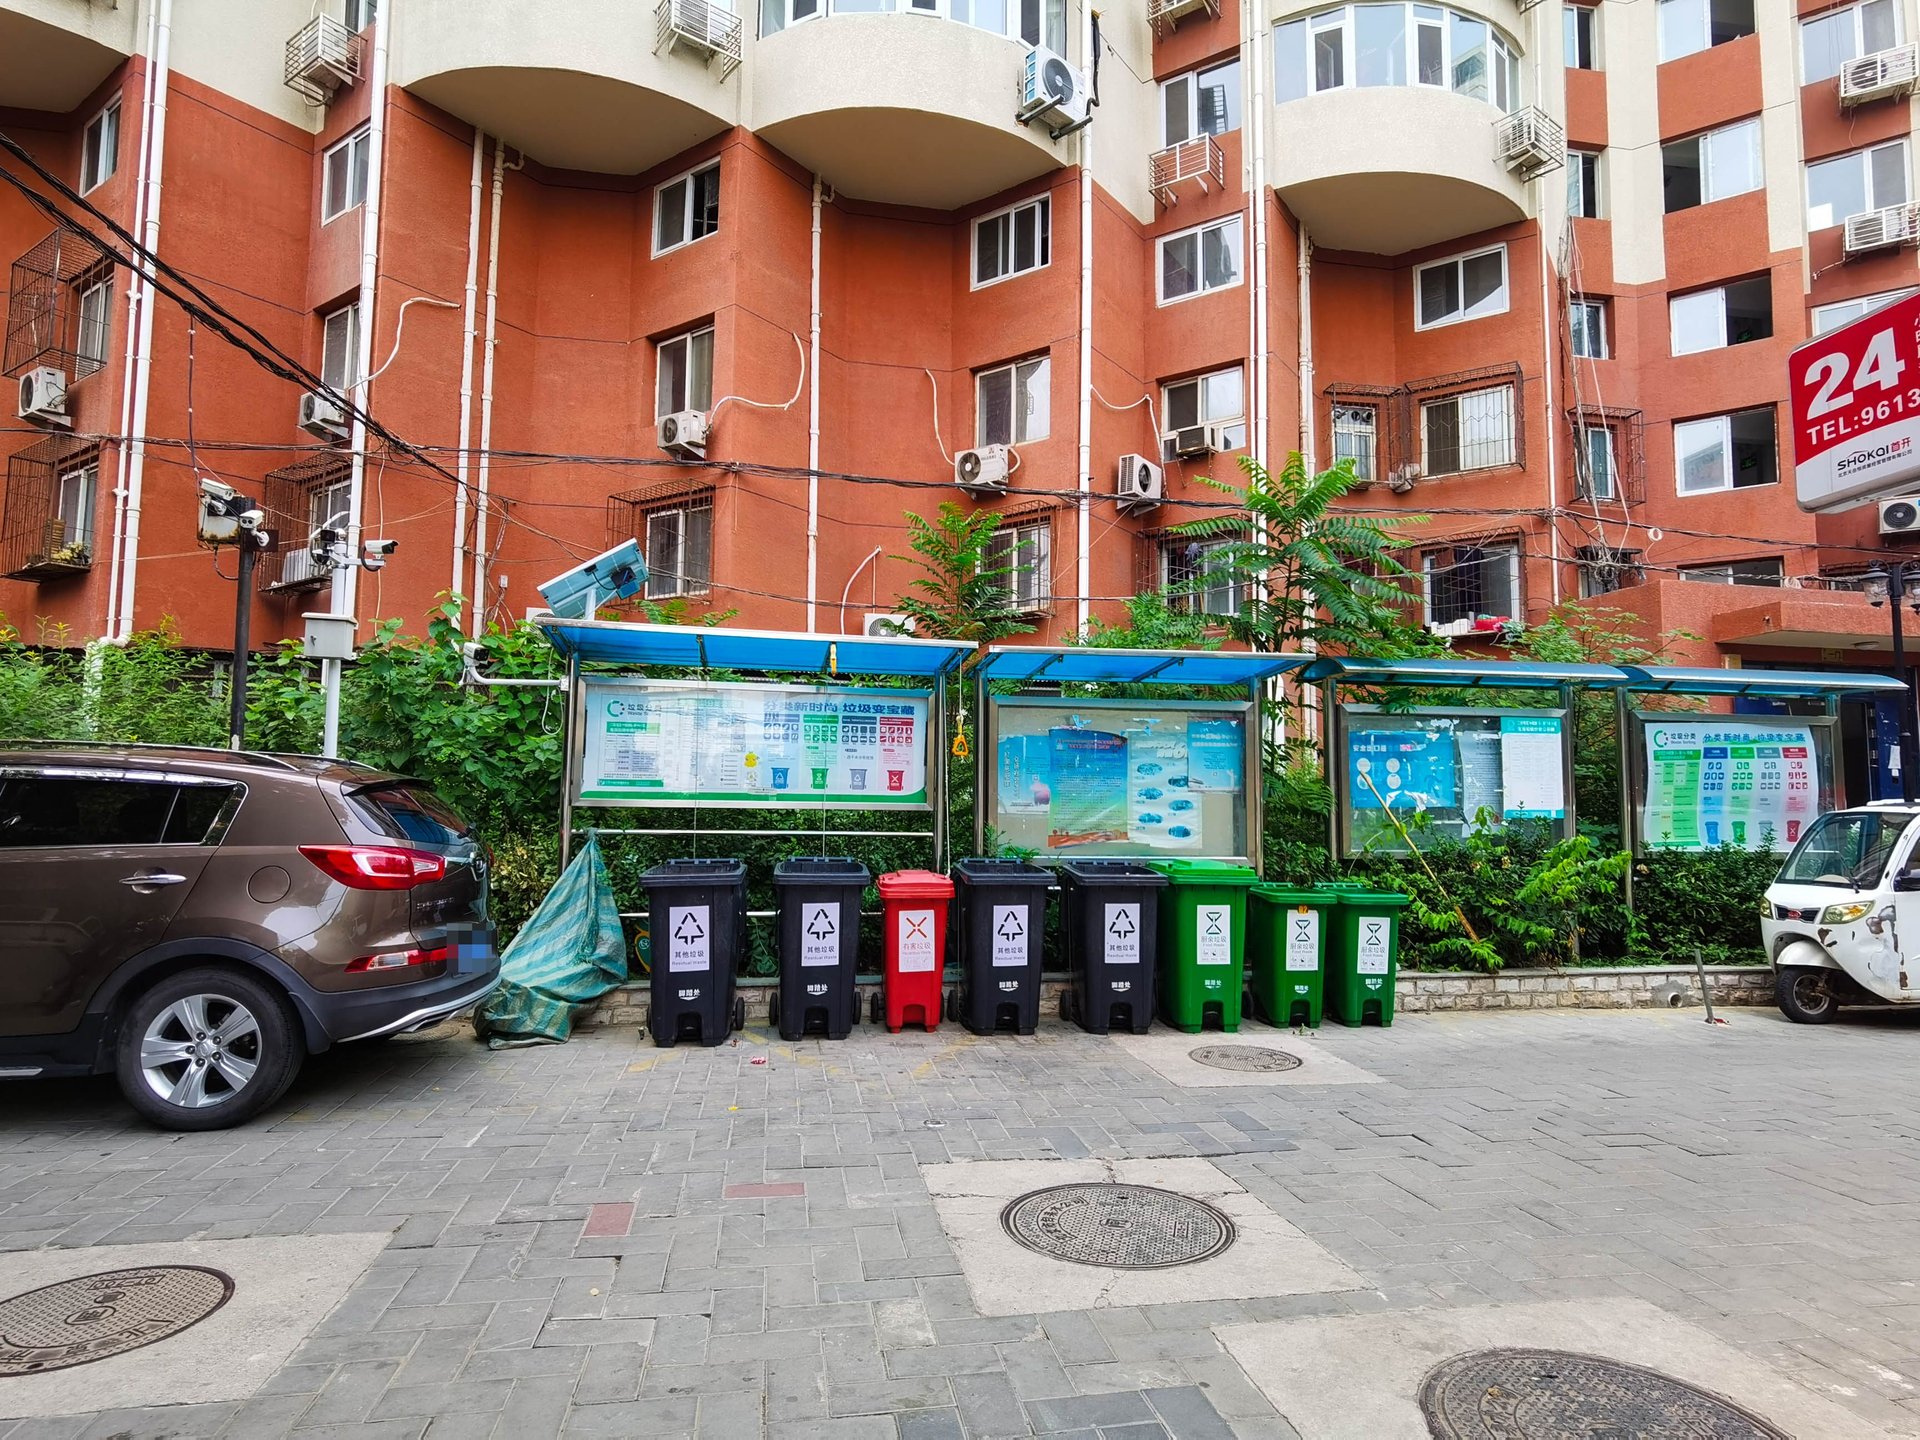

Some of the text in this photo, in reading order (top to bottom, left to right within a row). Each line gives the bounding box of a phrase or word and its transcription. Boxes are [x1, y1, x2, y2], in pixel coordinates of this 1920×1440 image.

[1804, 327, 1906, 421] 24
[842, 702, 915, 716] 垃圾变宝藏
